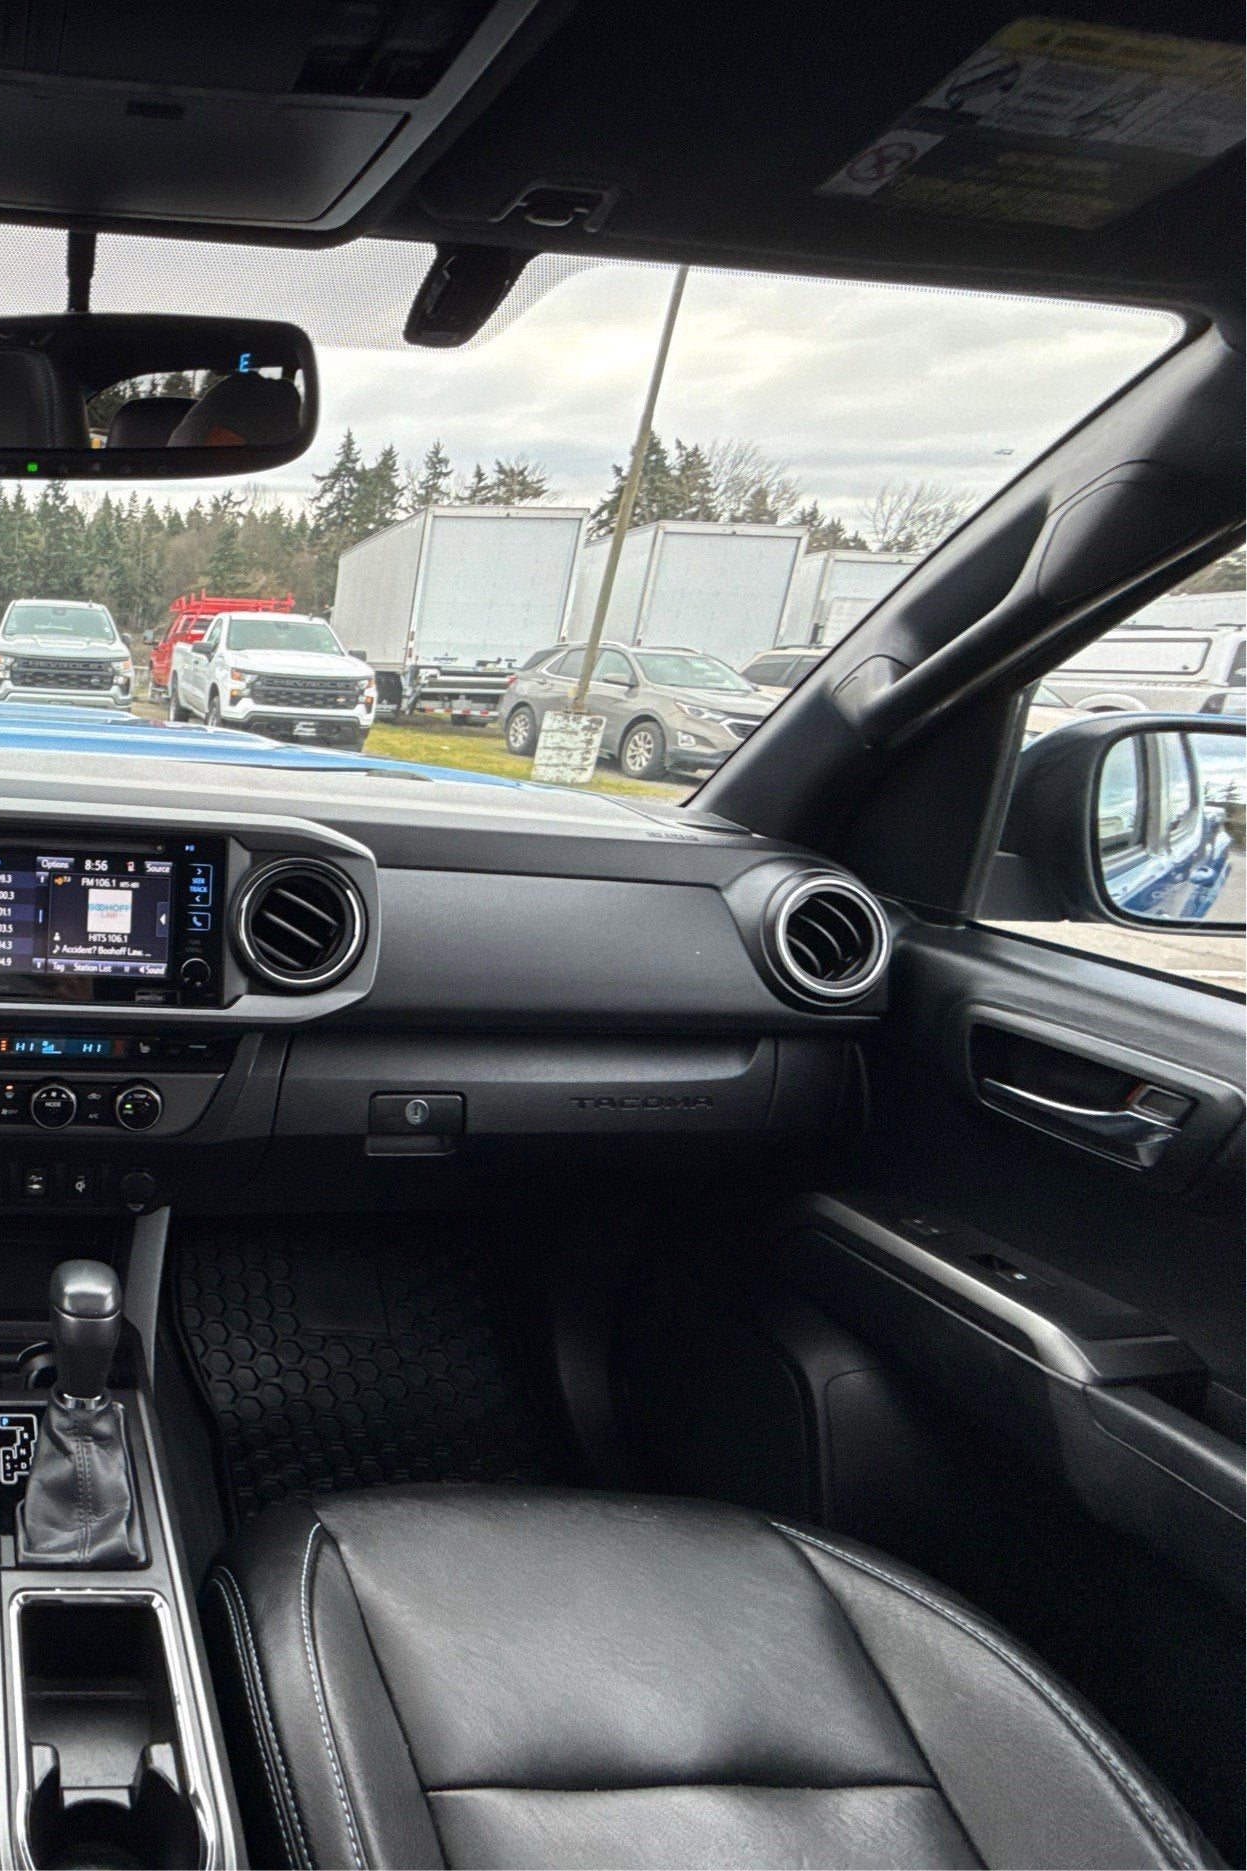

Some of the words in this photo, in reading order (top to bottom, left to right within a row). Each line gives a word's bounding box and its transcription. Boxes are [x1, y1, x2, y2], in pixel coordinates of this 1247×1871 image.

[239, 353, 251, 373] E
[41, 859, 70, 870] Options
[84, 860, 109, 871] 8:56
[146, 863, 170, 873] Source
[81, 877, 94, 887] FM
[95, 878, 116, 888] 106.1
[189, 885, 208, 893] TRACK
[88, 933, 107, 943] HITS
[108, 934, 129, 943] 106.1
[61, 944, 97, 955] Accident?
[97, 946, 126, 956] Boohoff
[52, 962, 66, 973] Tag
[73, 963, 98, 973] Station
[98, 965, 113, 973] List
[146, 966, 166, 976] Sound
[570, 1096, 714, 1111] TACOMA
